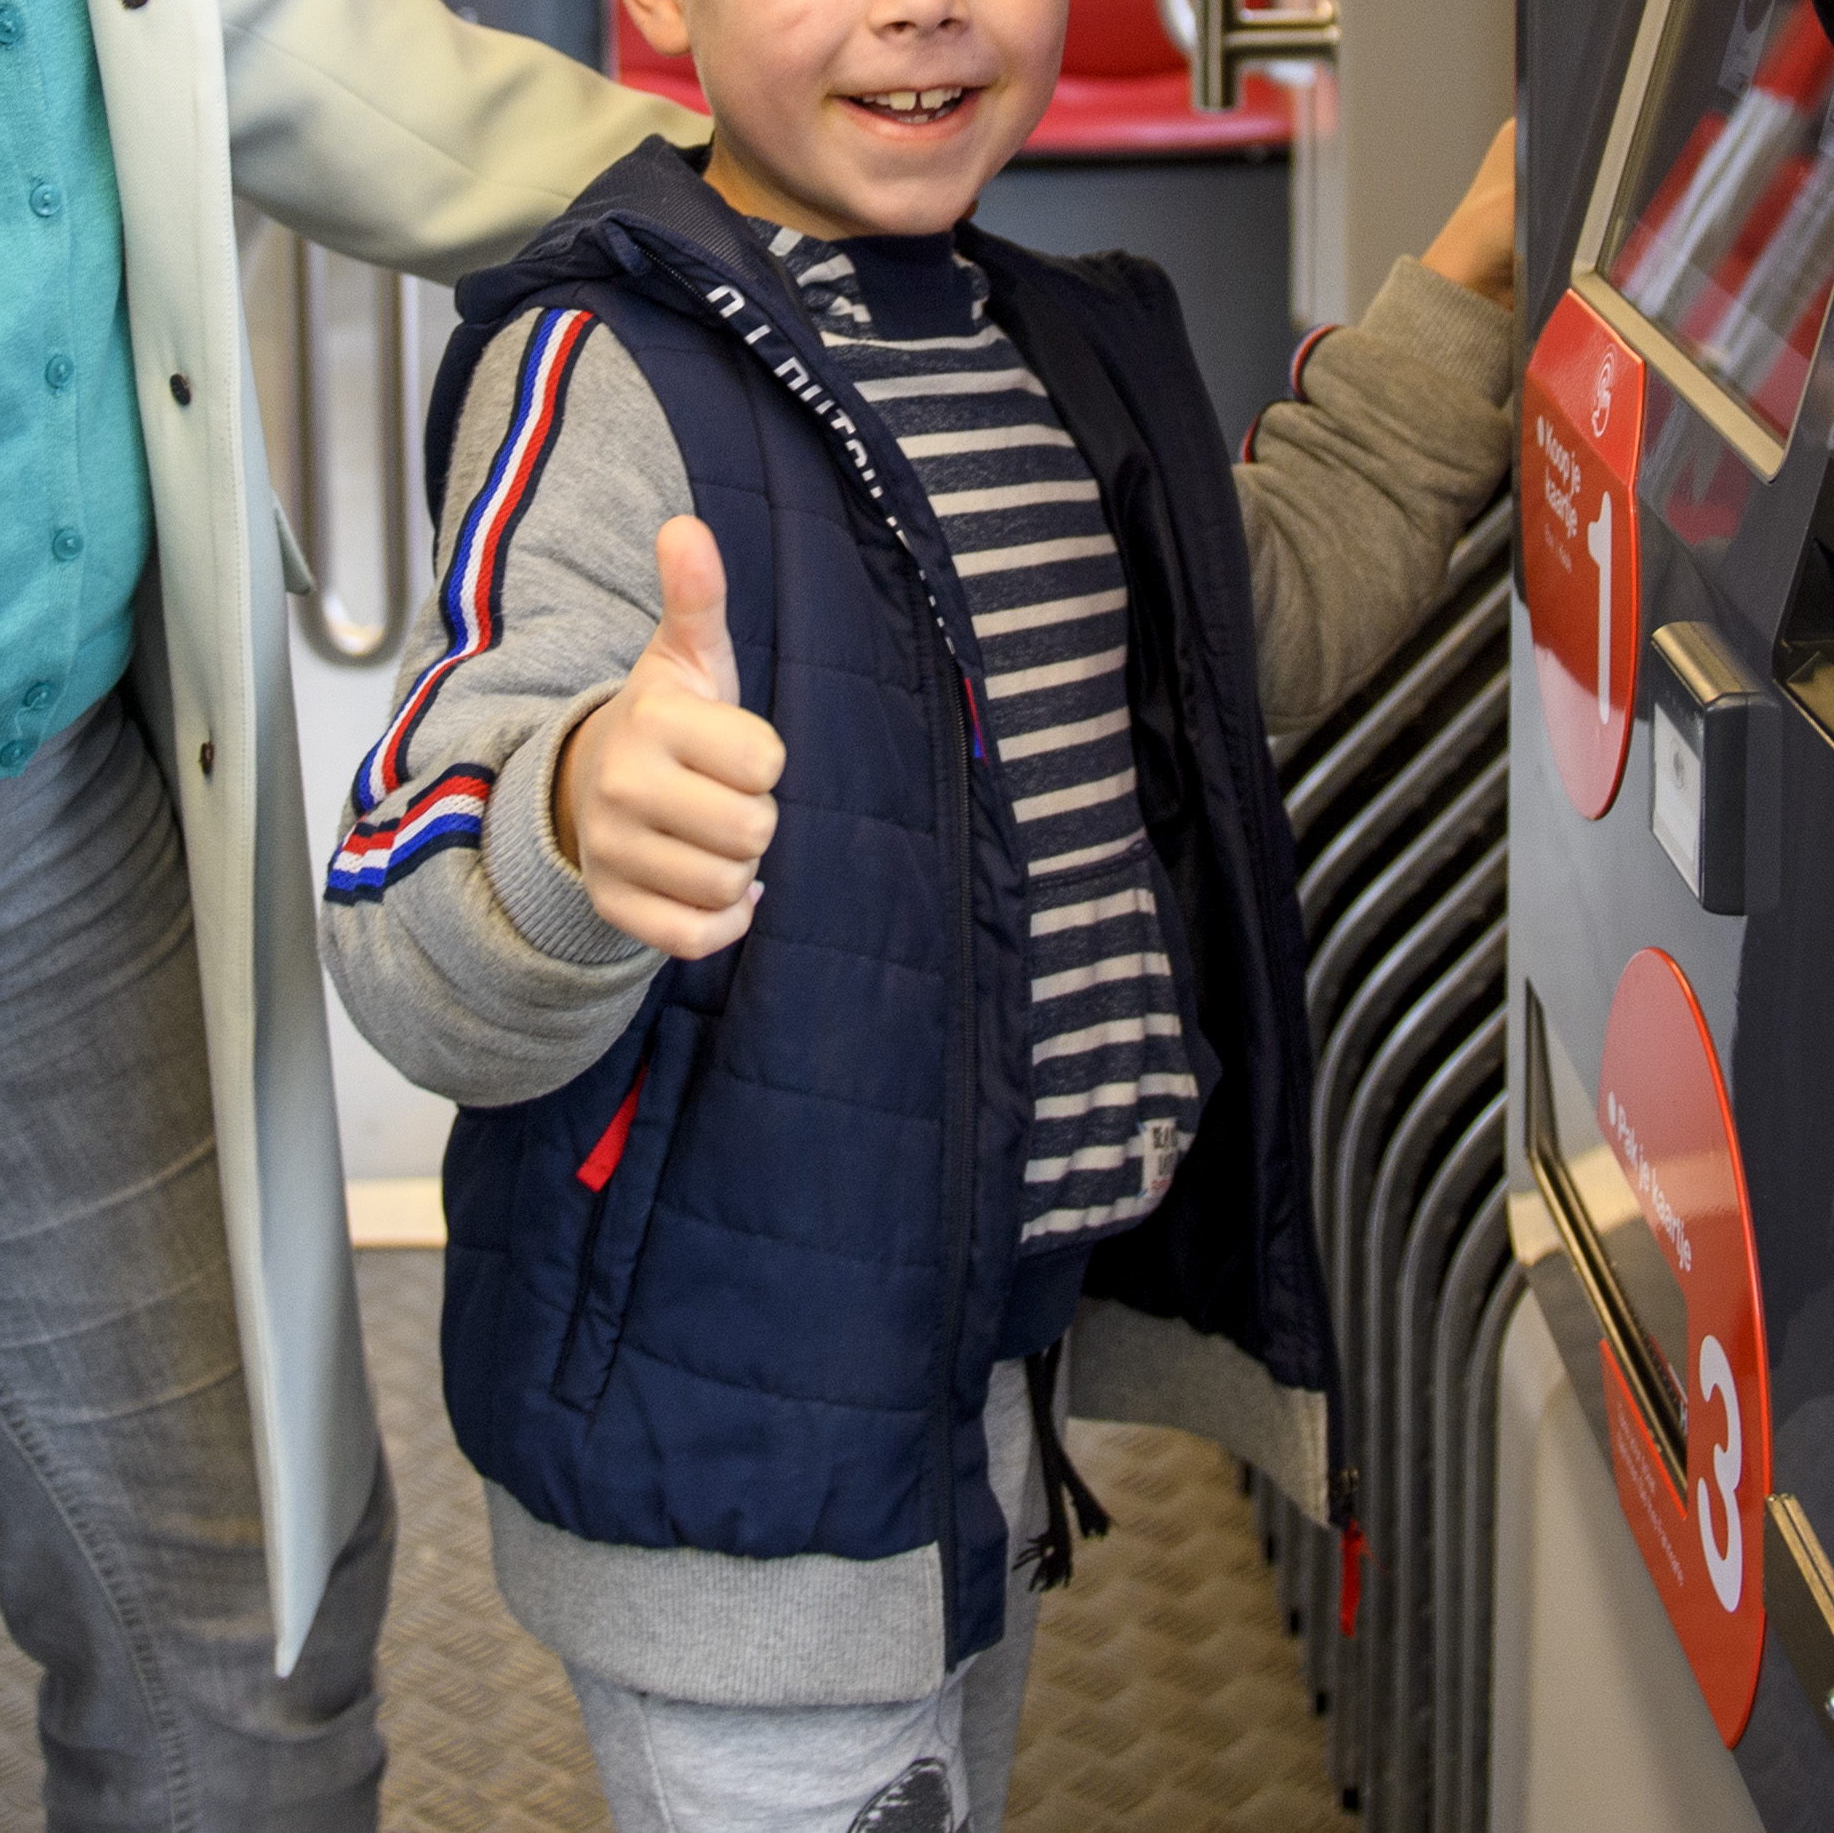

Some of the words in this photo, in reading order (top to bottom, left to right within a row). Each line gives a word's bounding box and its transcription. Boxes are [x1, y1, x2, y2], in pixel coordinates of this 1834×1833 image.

[1546, 420, 1570, 486] Koop
[1588, 491, 1613, 725] 1
[1617, 1103, 1639, 1172] Pak
[1651, 1167, 1693, 1273] kaartje
[1697, 1335, 1744, 1613] 3
